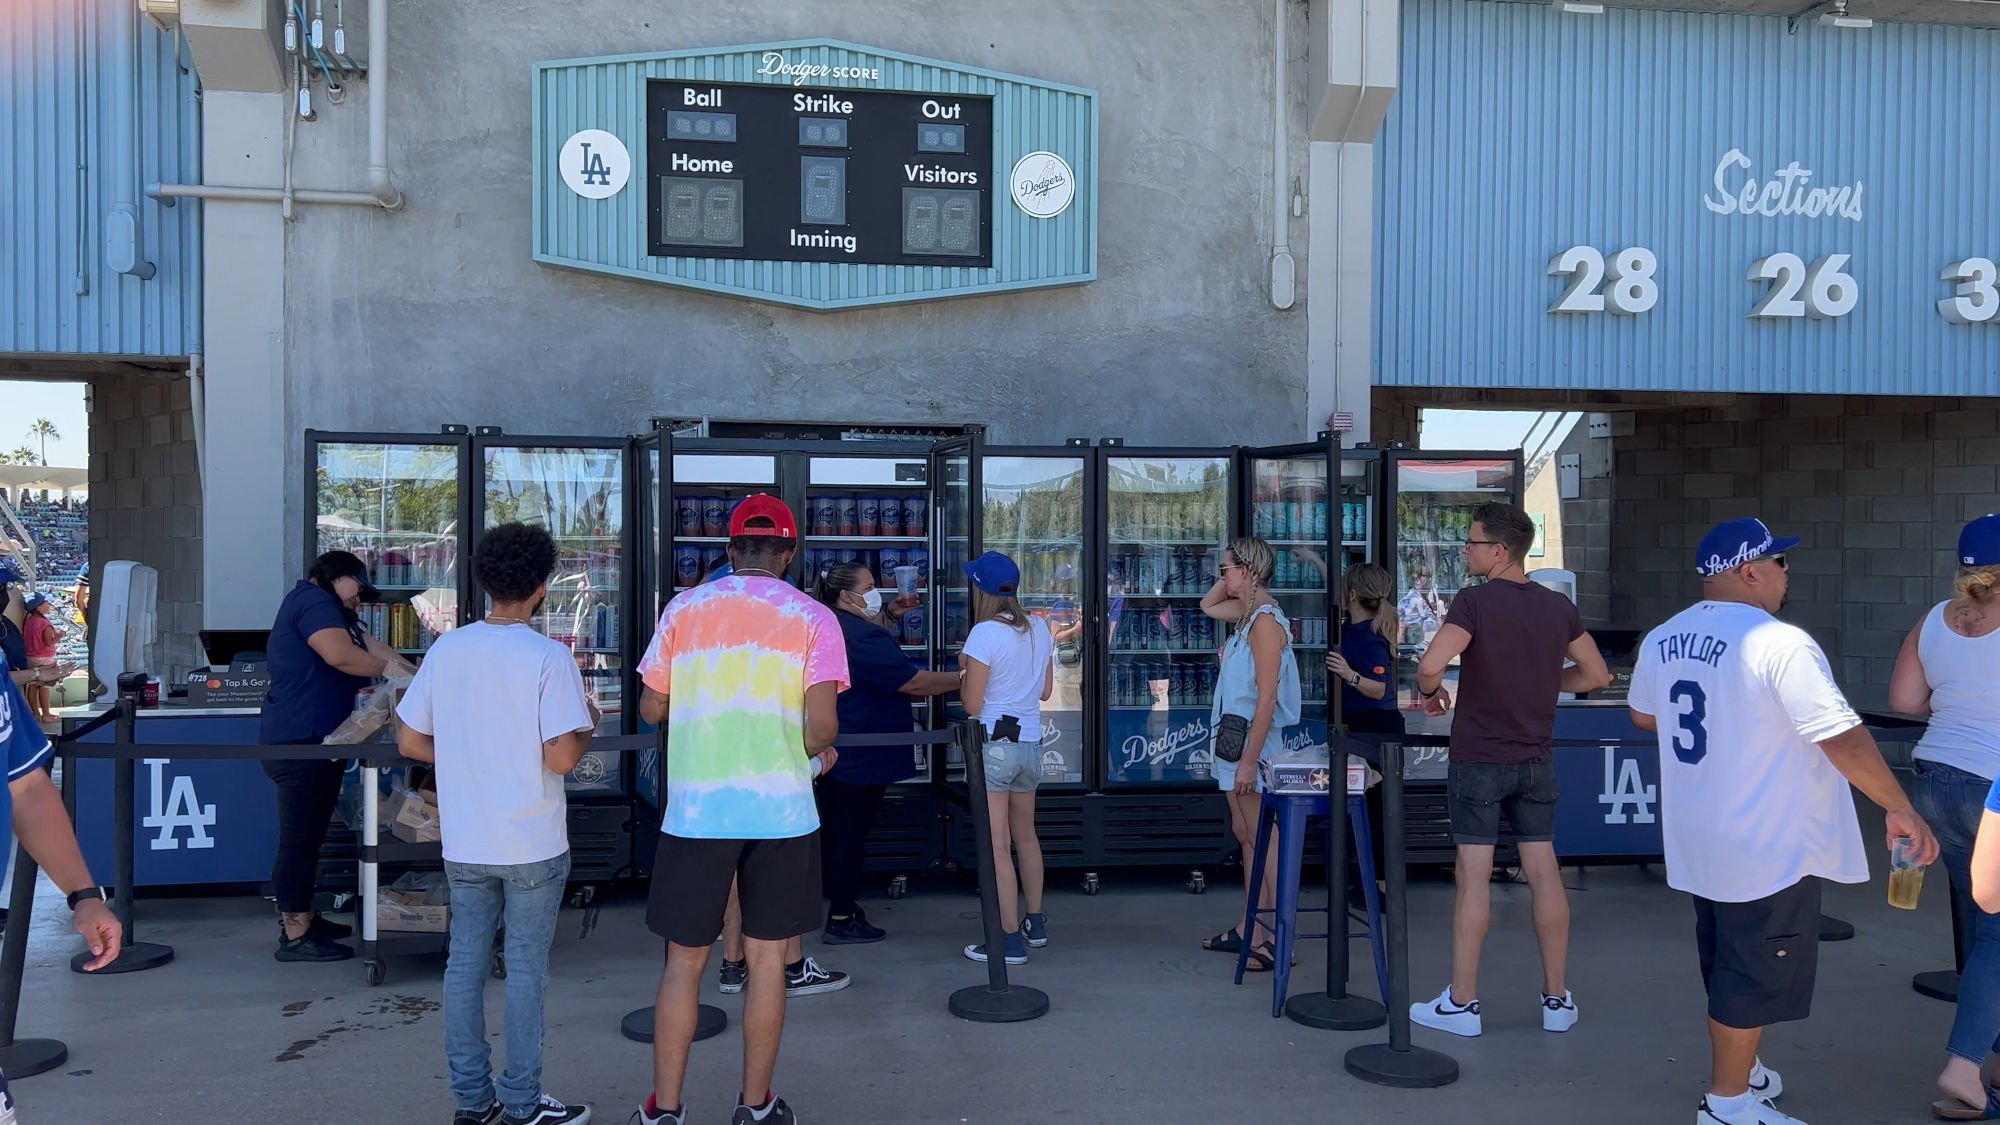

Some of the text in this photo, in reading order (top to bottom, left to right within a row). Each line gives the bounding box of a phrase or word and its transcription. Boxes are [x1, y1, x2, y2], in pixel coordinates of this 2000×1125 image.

[757, 52, 879, 86] Dodger SCORE
[683, 88, 722, 107] Ball
[793, 93, 854, 114] Strike
[922, 100, 961, 119] Out
[581, 143, 610, 185] LA
[672, 153, 734, 173] Home
[904, 164, 978, 184] Visitors
[1021, 172, 1066, 197] Dodgers
[1704, 148, 1863, 222] Sections
[790, 228, 857, 253] Inning
[1548, 245, 1659, 314] 28
[1747, 252, 1859, 318] 26
[1938, 257, 2000, 324] 3
[1705, 554, 1730, 577] Los
[1658, 632, 1728, 668] TAYLOR
[188, 674, 207, 683] #728
[224, 679, 240, 688] Tap
[242, 679, 248, 687] &
[1616, 673, 1630, 681] Tap
[1669, 679, 1708, 765] 3
[1121, 717, 1208, 768] Dodgers
[1598, 738, 1656, 824] LA
[143, 758, 216, 850] LA
